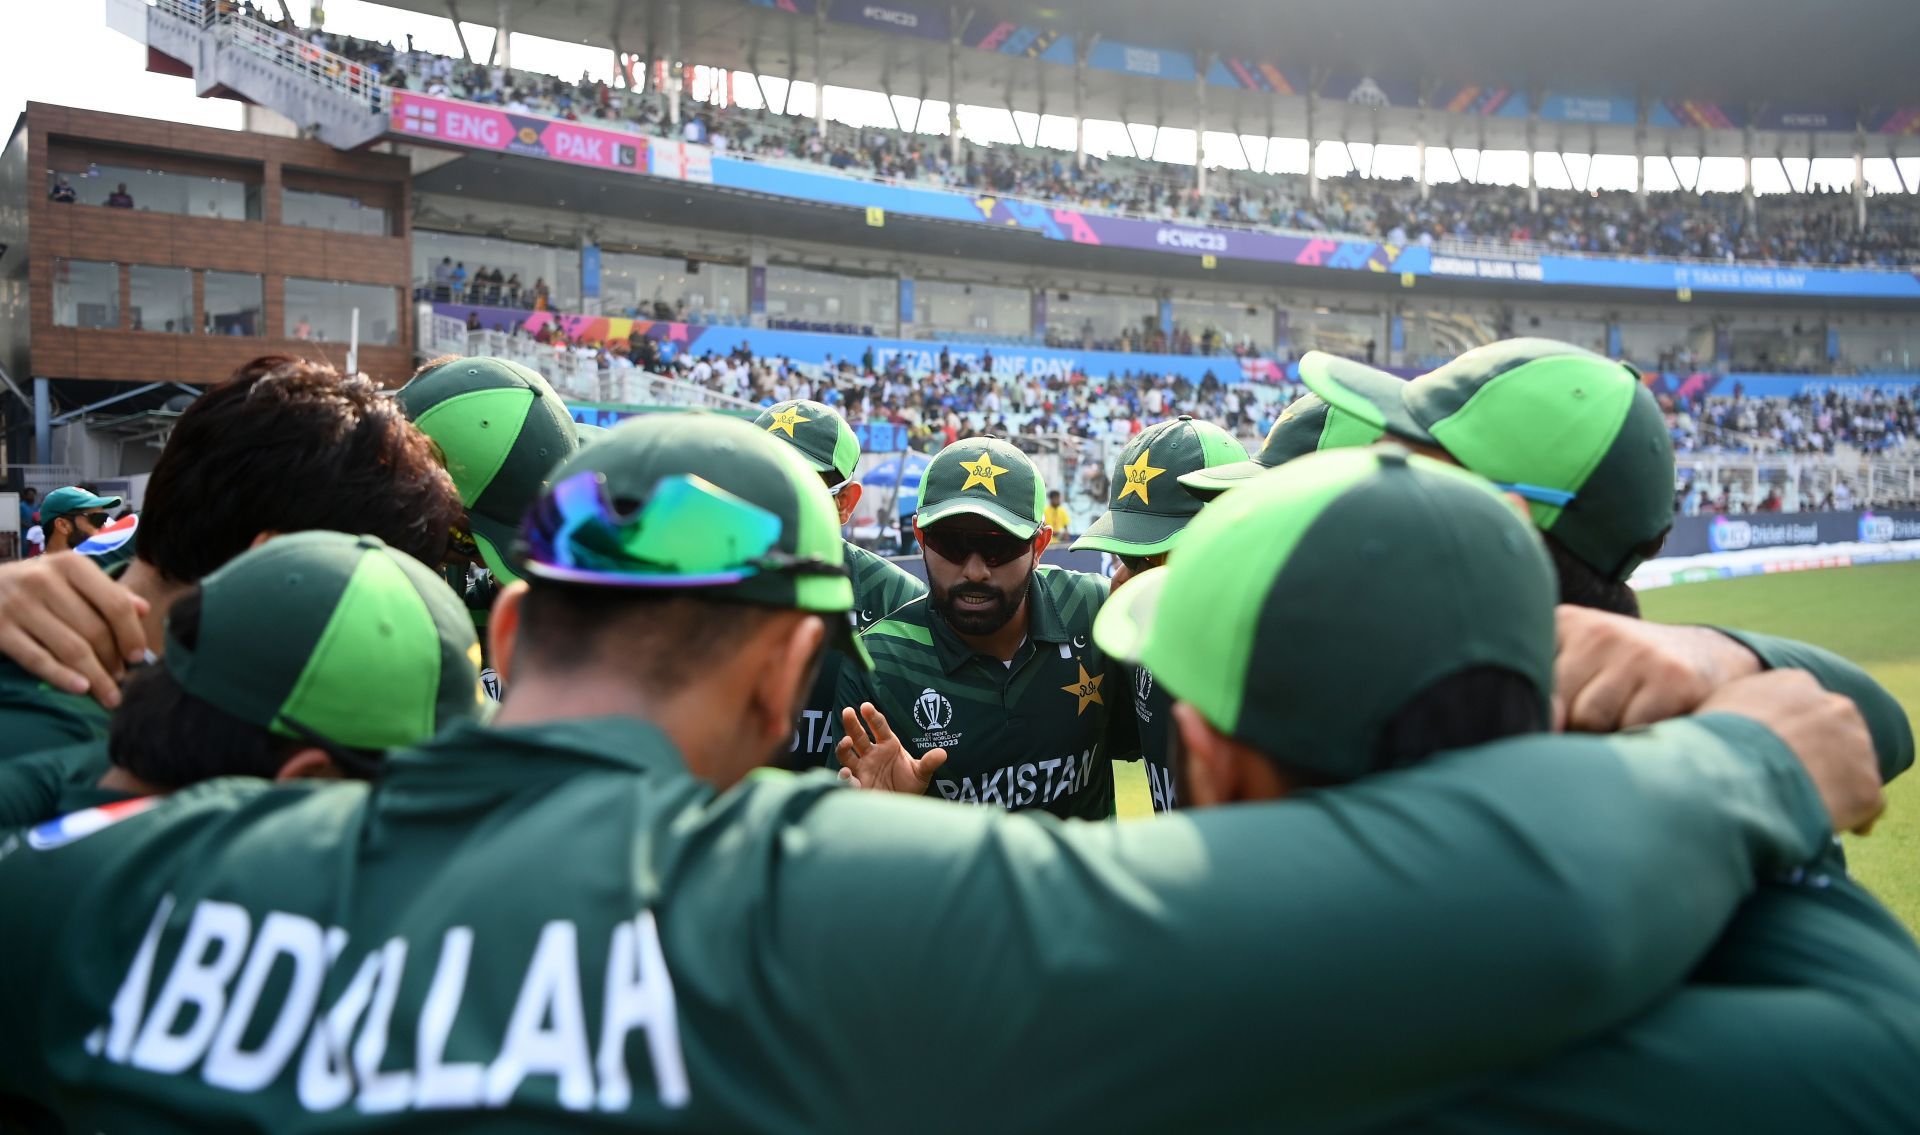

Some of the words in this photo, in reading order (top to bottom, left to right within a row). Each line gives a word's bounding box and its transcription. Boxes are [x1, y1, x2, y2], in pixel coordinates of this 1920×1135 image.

[863, 7, 918, 27] #CWC23
[445, 112, 499, 144] ENG
[555, 131, 604, 162] PAK
[1156, 228, 1228, 251] #CWC23
[932, 734, 951, 742] WORLD
[938, 739, 959, 748] 2023
[935, 743, 1098, 809] PAKISTAN
[83, 893, 692, 1114] ABDULLAH
